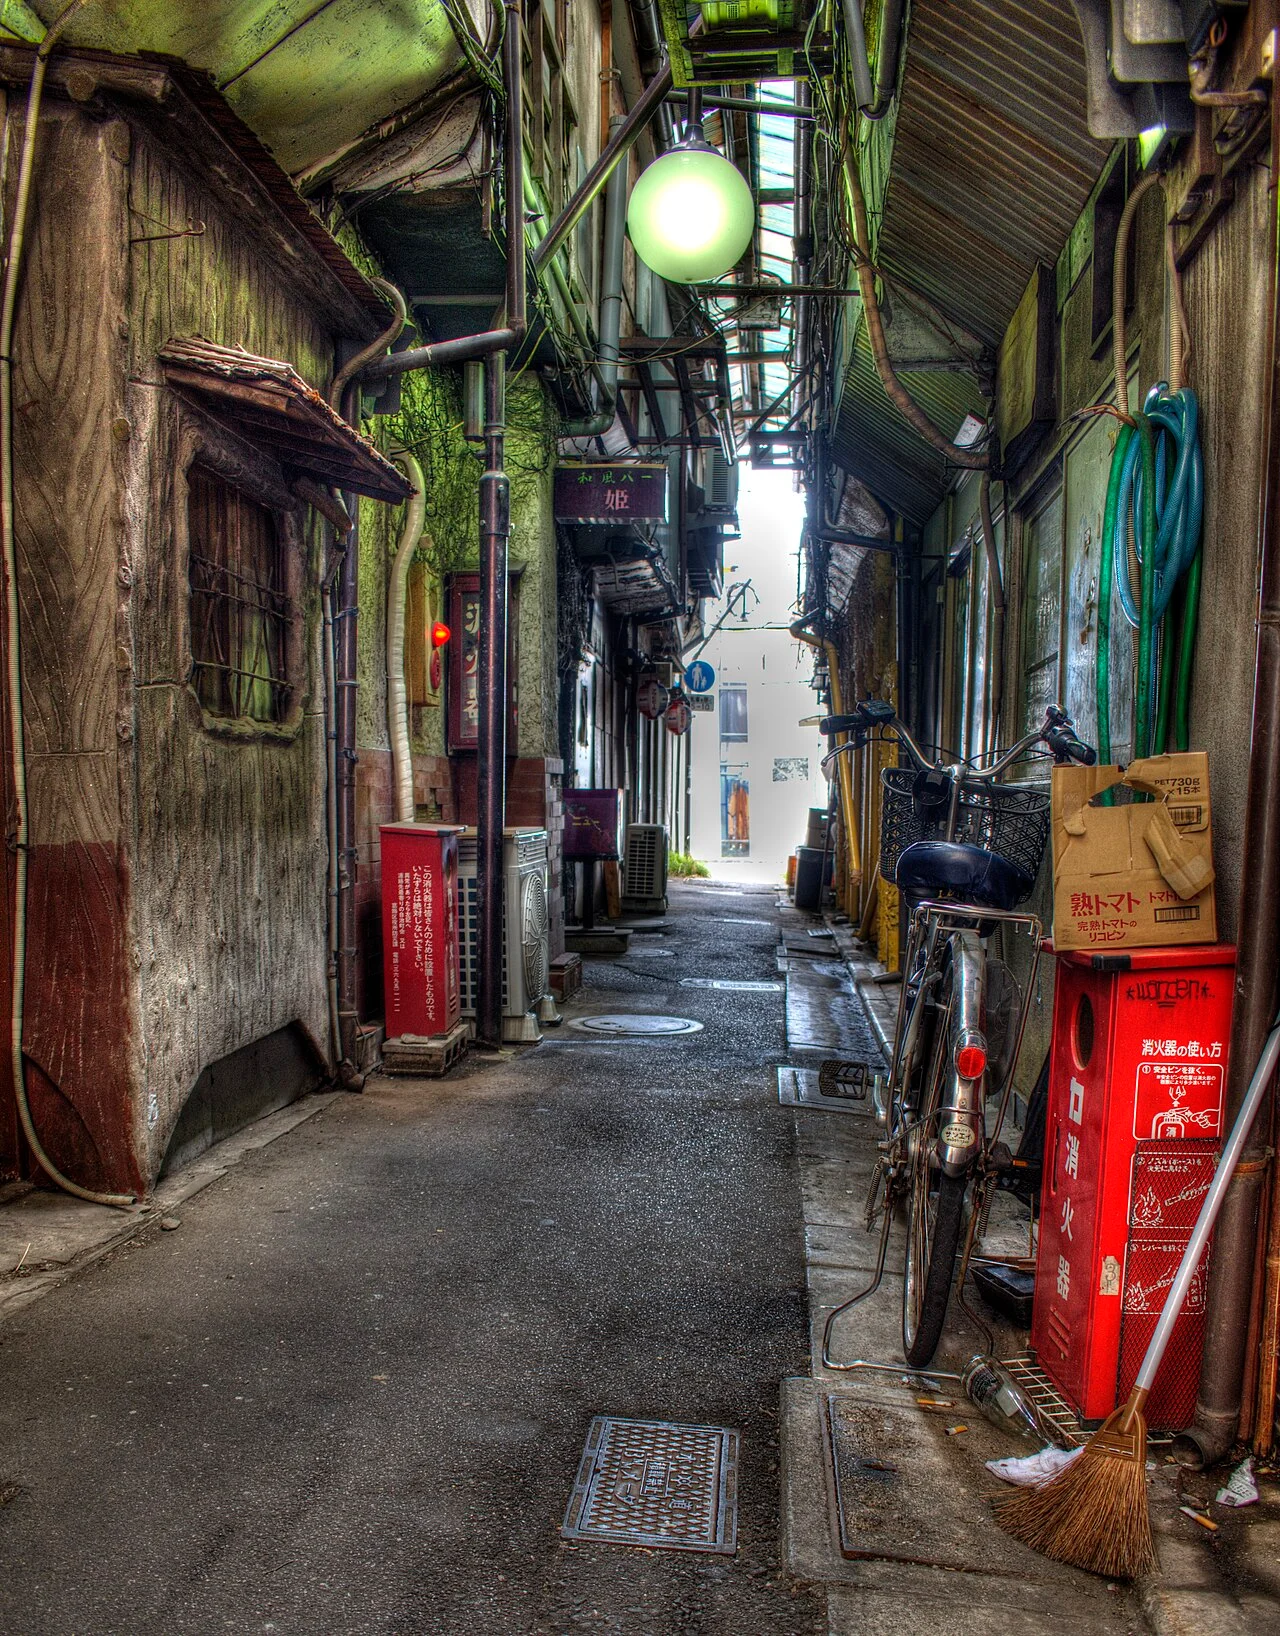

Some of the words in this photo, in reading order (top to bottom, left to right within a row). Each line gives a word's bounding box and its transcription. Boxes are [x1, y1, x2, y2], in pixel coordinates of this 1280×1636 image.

[577, 471, 652, 484] 和風バー
[604, 488, 630, 511] 姫
[1154, 777, 1200, 787] PET730g
[1070, 892, 1141, 917] 熟トマト
[1077, 919, 1137, 931] 完熟トマトの
[1089, 931, 1126, 942] リコピン
[1141, 1039, 1223, 1058] 消火器の使い方
[1153, 1066, 1205, 1074] 安全ピンを抜く。
